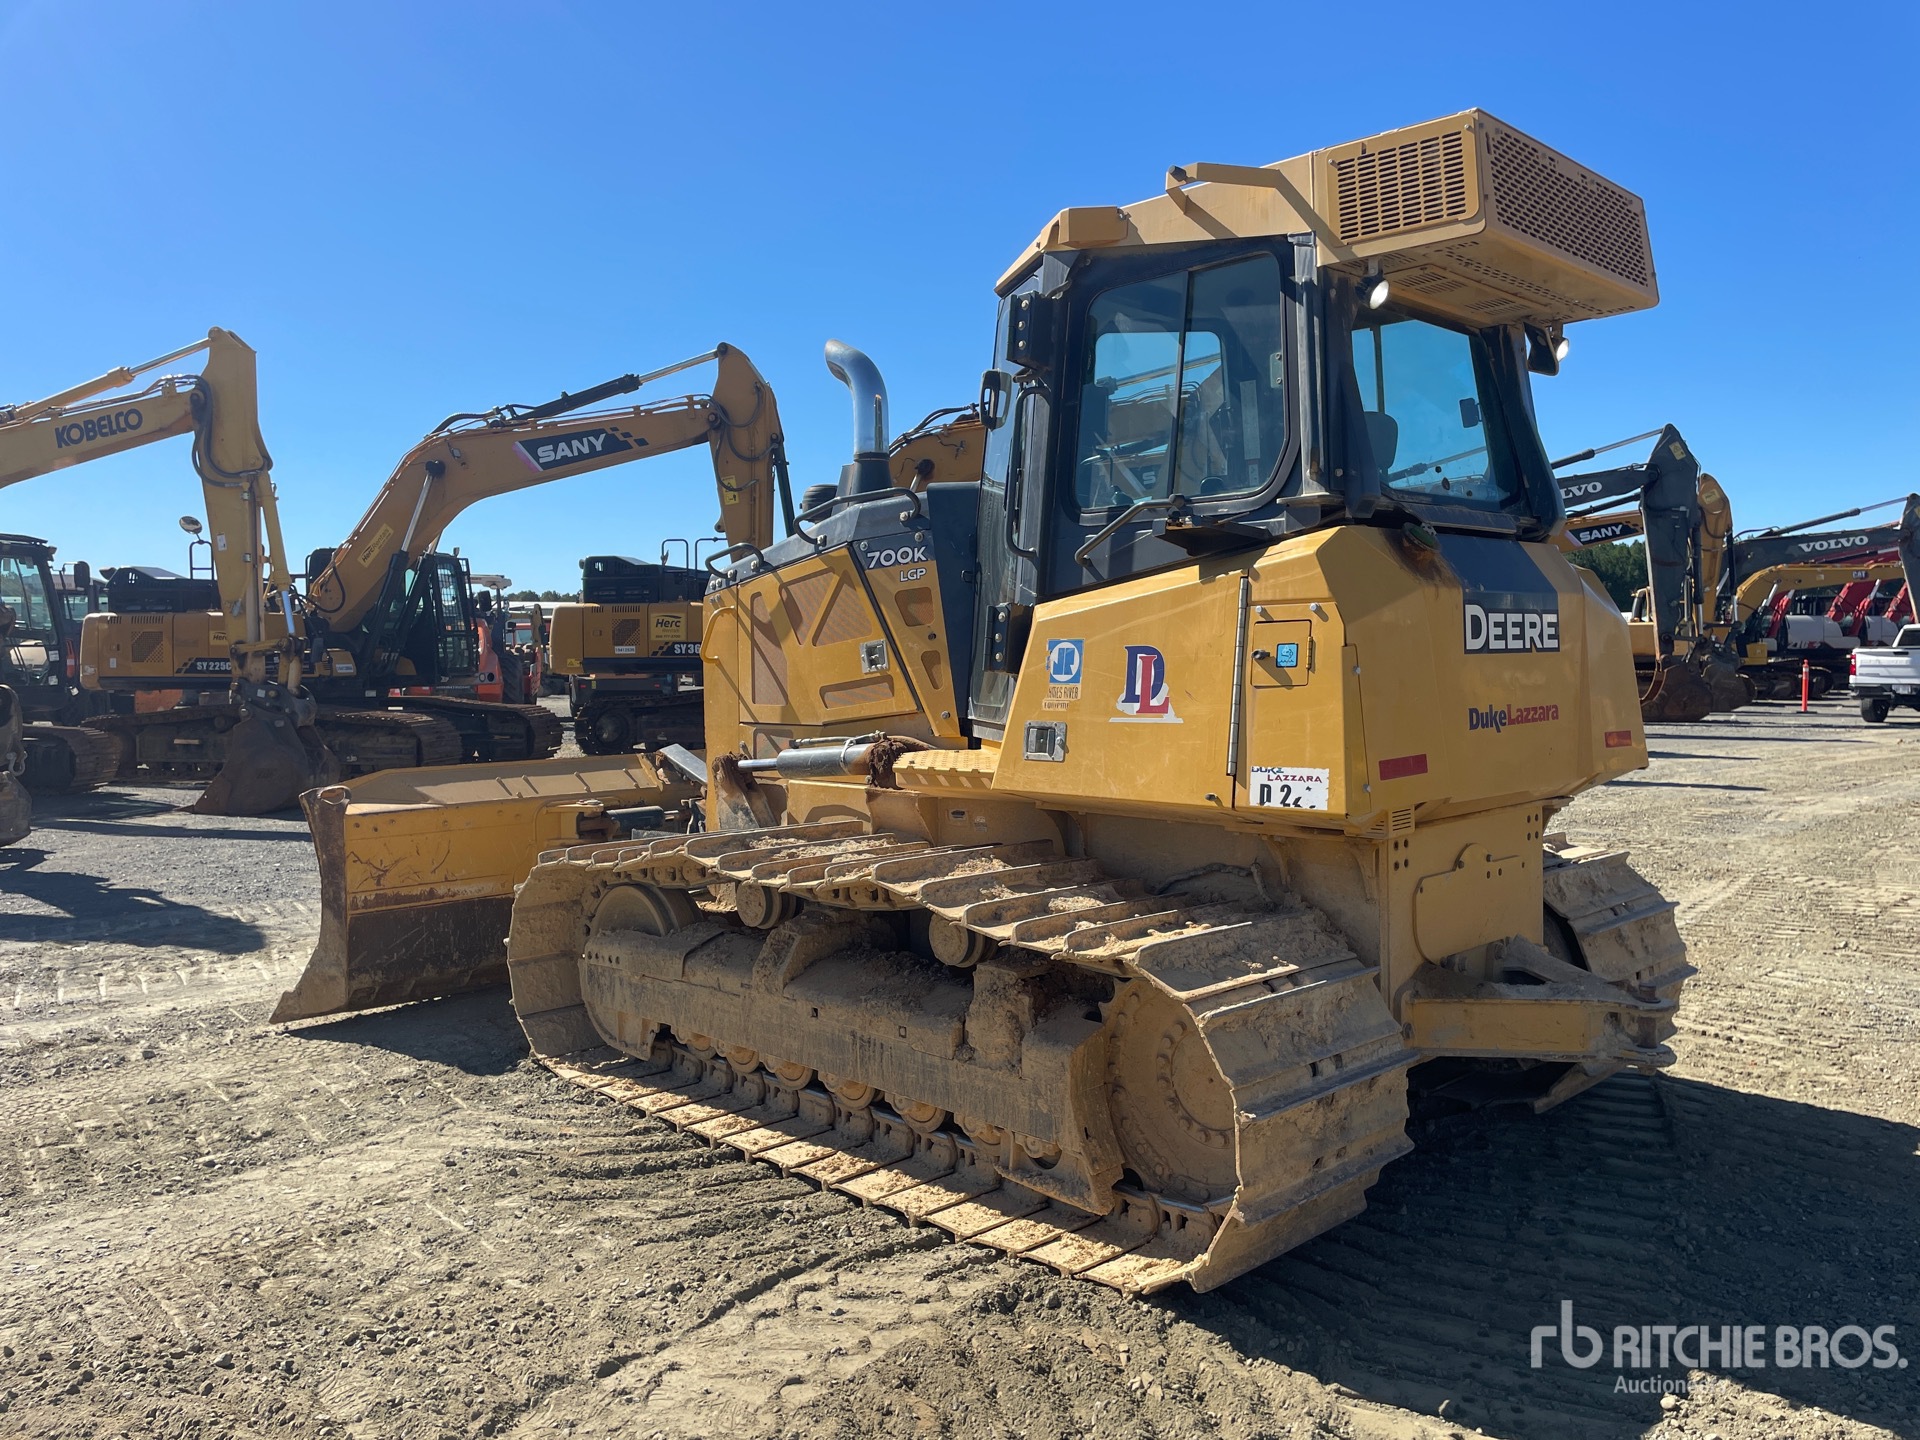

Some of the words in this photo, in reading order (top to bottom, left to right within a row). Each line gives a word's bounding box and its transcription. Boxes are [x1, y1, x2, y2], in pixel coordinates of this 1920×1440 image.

[55, 408, 143, 448] KOBELCO
[537, 433, 606, 463] SANY
[1560, 481, 1603, 499] LVO
[1580, 524, 1623, 541] SANY
[1798, 535, 1869, 553] VOLVO
[867, 546, 927, 569] 700K
[900, 568, 926, 582] LGP
[655, 618, 681, 628] Herc
[1464, 604, 1559, 650] DEERE
[674, 643, 700, 654] SY36
[196, 661, 231, 671] SY225C
[1267, 774, 1322, 783] LAZZARA
